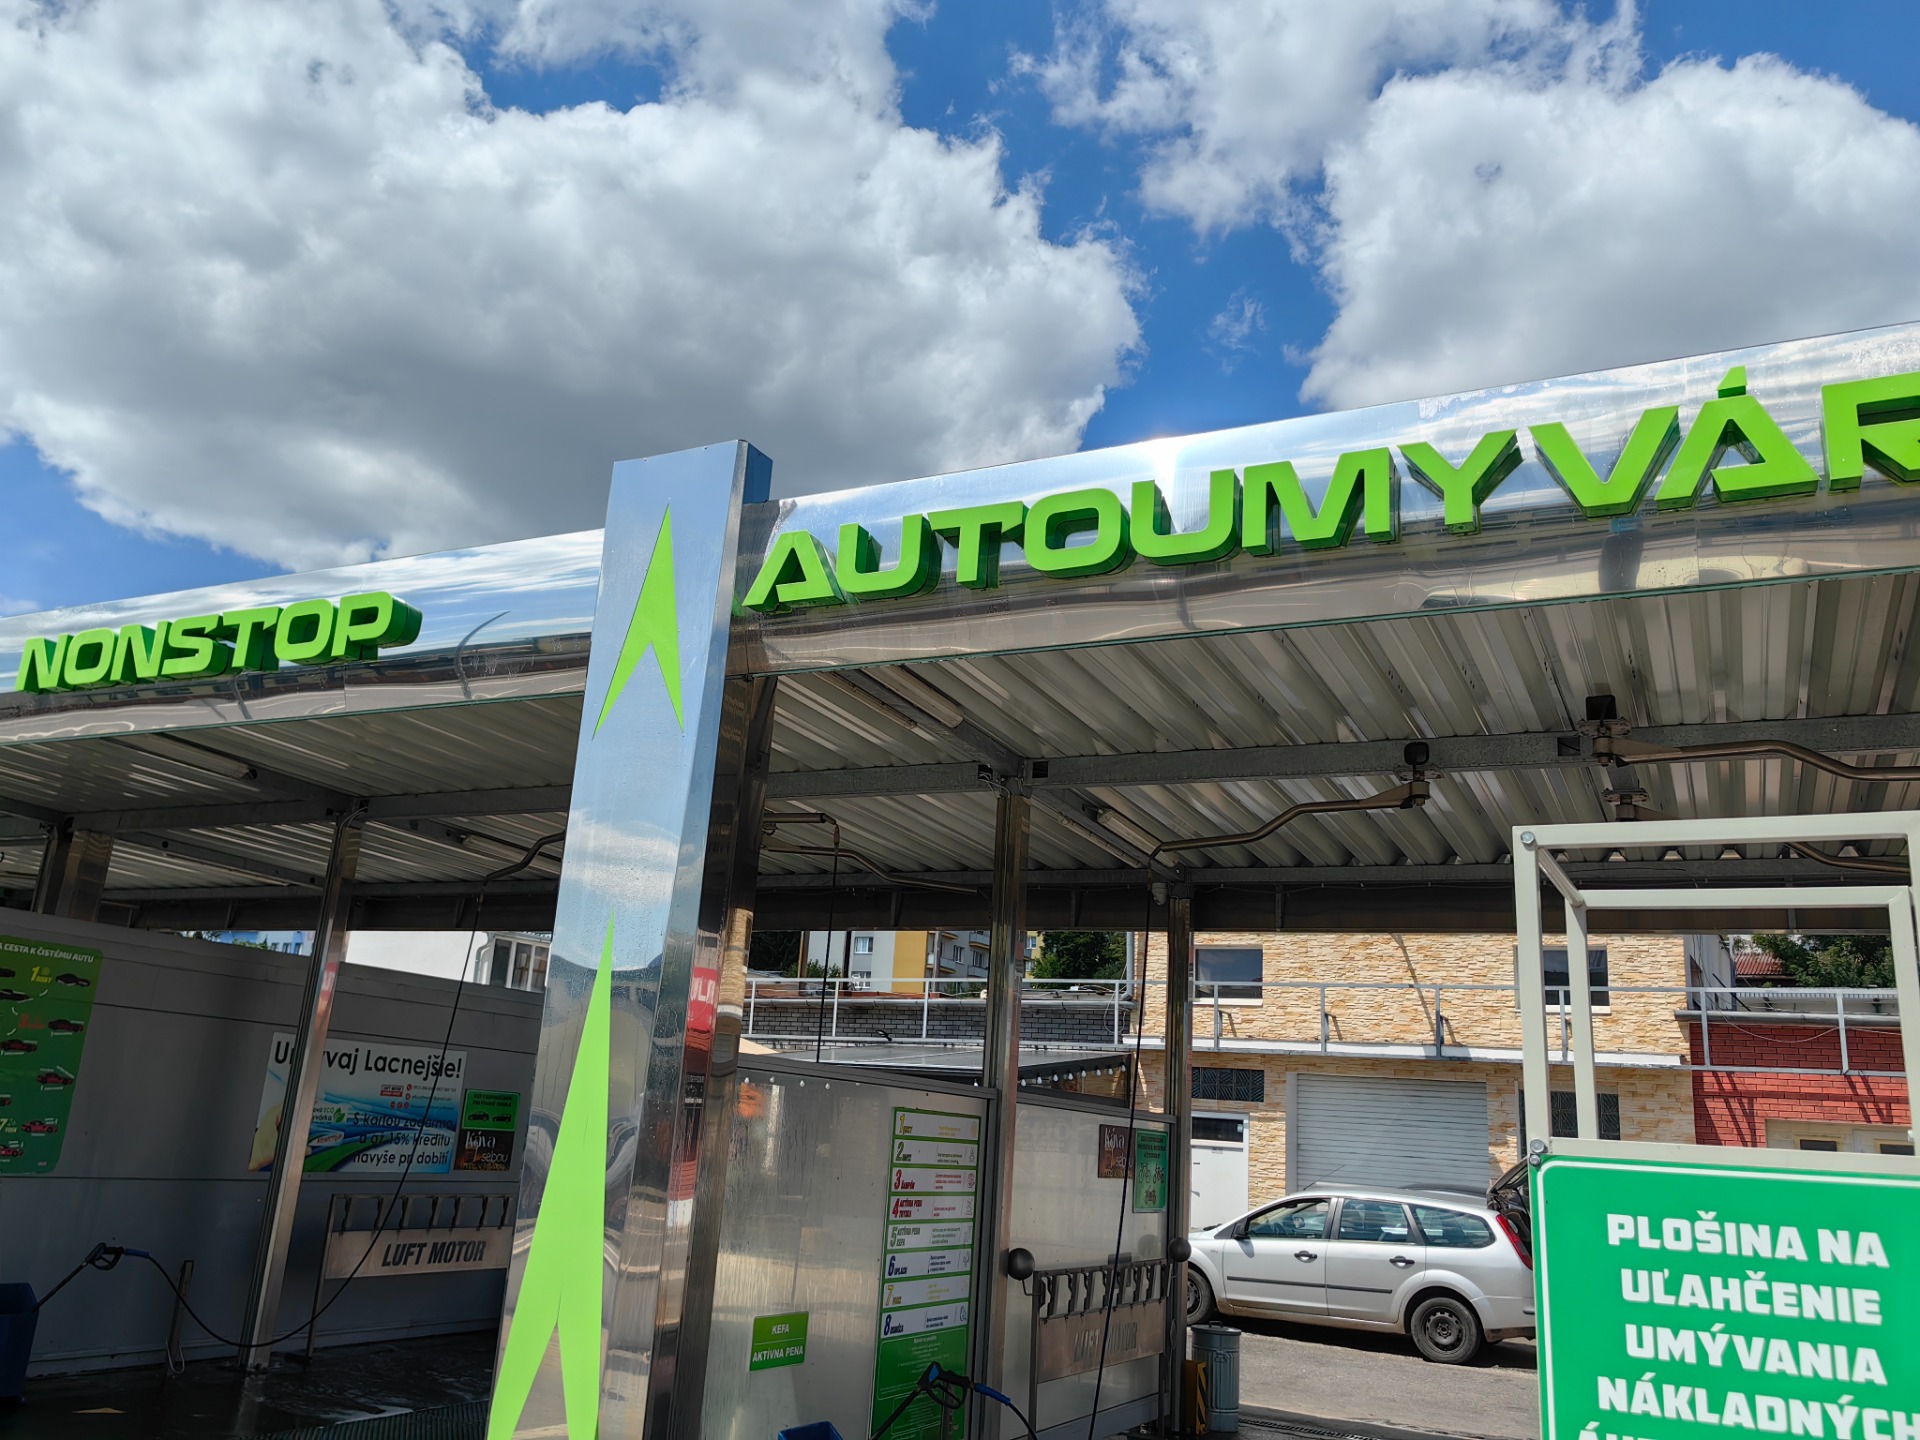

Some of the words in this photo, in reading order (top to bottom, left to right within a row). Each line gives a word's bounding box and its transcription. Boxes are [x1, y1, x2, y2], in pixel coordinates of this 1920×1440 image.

[15, 592, 402, 693] NONSTOP
[4, 943, 29, 954] CESTA
[30, 947, 37, 955] K
[72, 953, 94, 963] AUTU
[274, 1041, 359, 1075] Uvaj
[365, 1050, 462, 1081] Lacnejšie!
[353, 1112, 360, 1125] S
[389, 1132, 410, 1146] 15%
[353, 1149, 396, 1166] navyše
[481, 1150, 508, 1163] sebou
[896, 1141, 904, 1161] 2
[894, 1169, 902, 1190] 3
[892, 1198, 900, 1218] 4
[890, 1226, 898, 1247] 5
[1606, 1210, 1809, 1262] PLOŠINA
[1817, 1228, 1891, 1269] NA
[381, 1242, 428, 1267] LUFT
[427, 1240, 487, 1264] MOTOR
[888, 1255, 896, 1276] 6
[886, 1284, 894, 1306] 7
[1620, 1267, 1883, 1326] UĽAHČENIE
[772, 1323, 790, 1335] KEFA
[884, 1314, 892, 1336] 8
[752, 1347, 784, 1362] AKTÍVNA
[785, 1345, 804, 1357] PENA
[1625, 1322, 1889, 1386] UMÝVANIA
[1597, 1372, 1920, 1440] NÁKLADNÝCH
